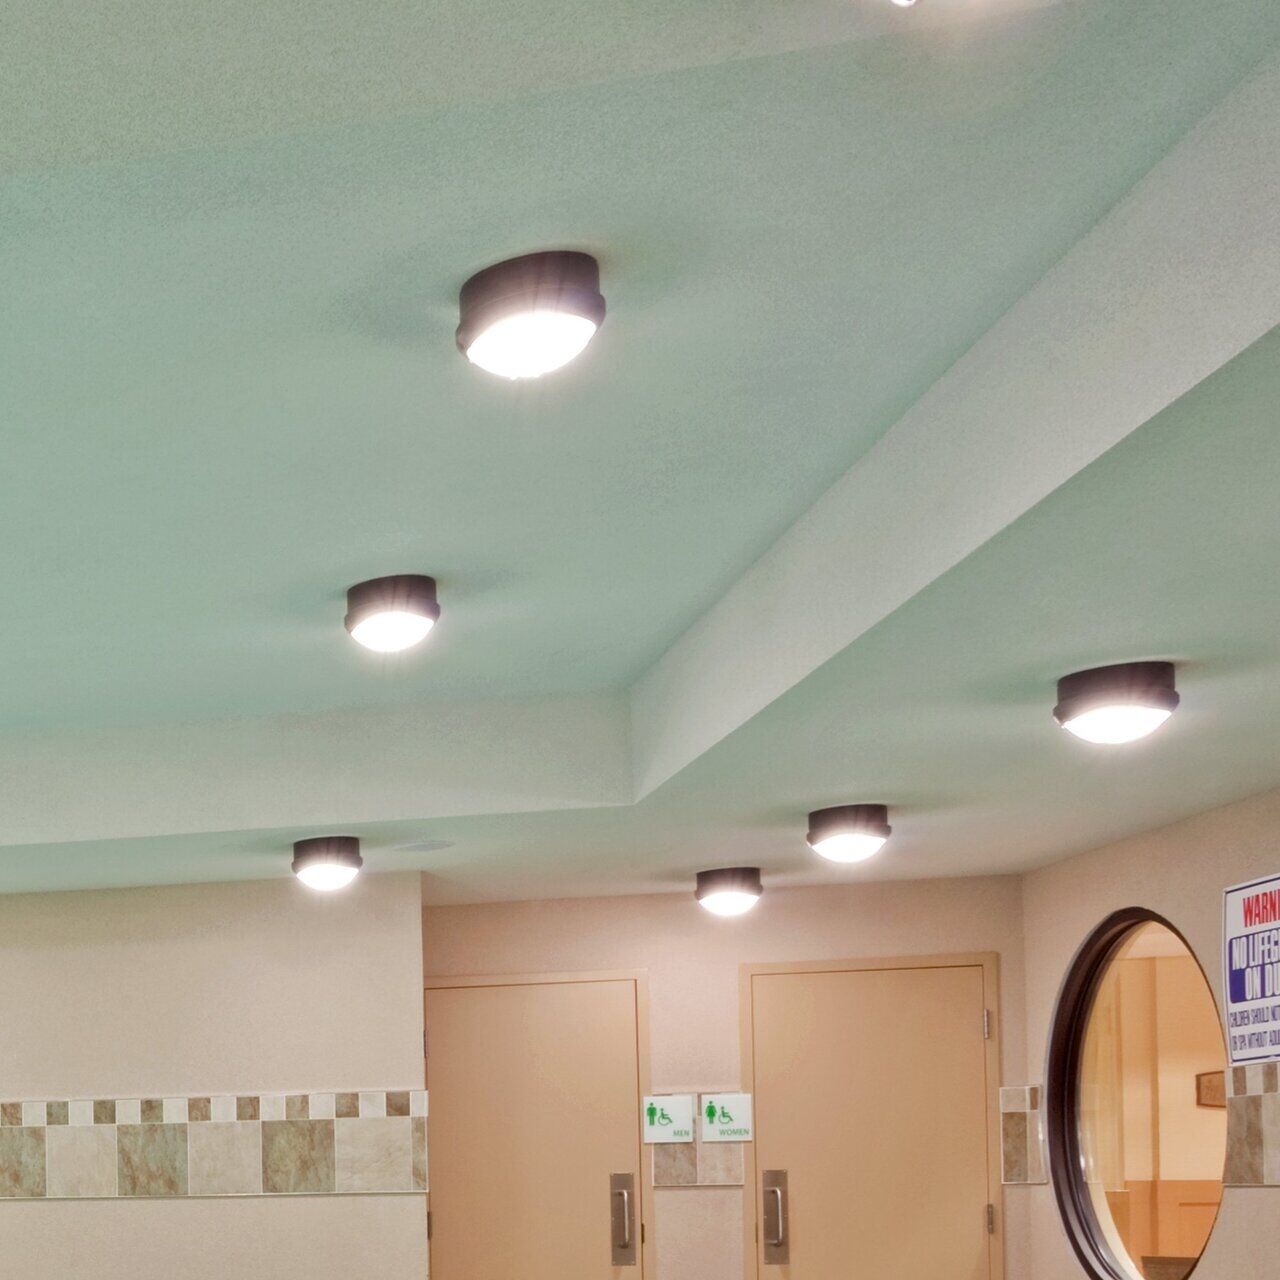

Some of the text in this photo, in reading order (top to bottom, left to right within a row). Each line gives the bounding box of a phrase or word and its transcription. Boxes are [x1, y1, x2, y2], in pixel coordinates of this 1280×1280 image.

[1232, 929, 1280, 970] NO LIFEG
[1245, 966, 1262, 1001] ON
[673, 1129, 690, 1137] MEN
[719, 1128, 749, 1136] WOMEN
